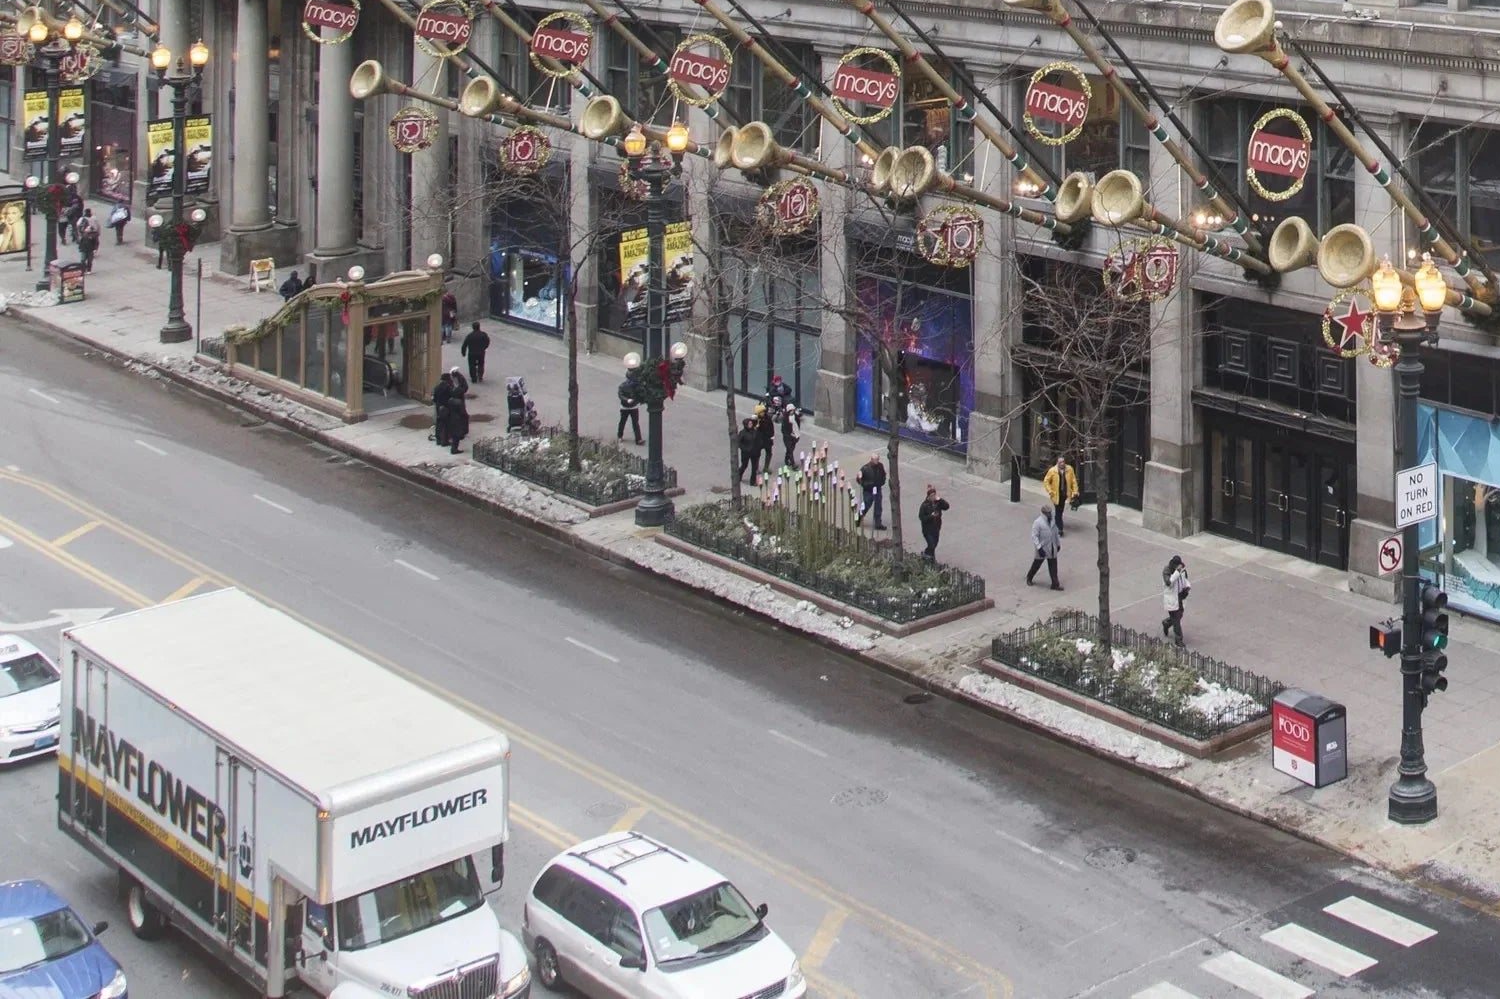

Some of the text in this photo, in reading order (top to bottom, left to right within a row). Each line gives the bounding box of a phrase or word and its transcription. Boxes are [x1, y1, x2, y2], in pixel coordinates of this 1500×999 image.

[307, 5, 356, 28] macy's
[418, 17, 470, 39] macy's
[534, 33, 589, 59] macy's
[672, 56, 728, 86] macy's
[835, 72, 896, 101] macy's
[1028, 88, 1086, 121] macy's
[1252, 141, 1307, 173] macy's
[1409, 473, 1423, 486] NO
[1405, 487, 1428, 502] TURN
[1400, 501, 1433, 520] ON RED
[1278, 716, 1310, 742] FOOD
[75, 707, 227, 862] MAYFLOWER
[350, 788, 488, 849] MAYFLOWER
